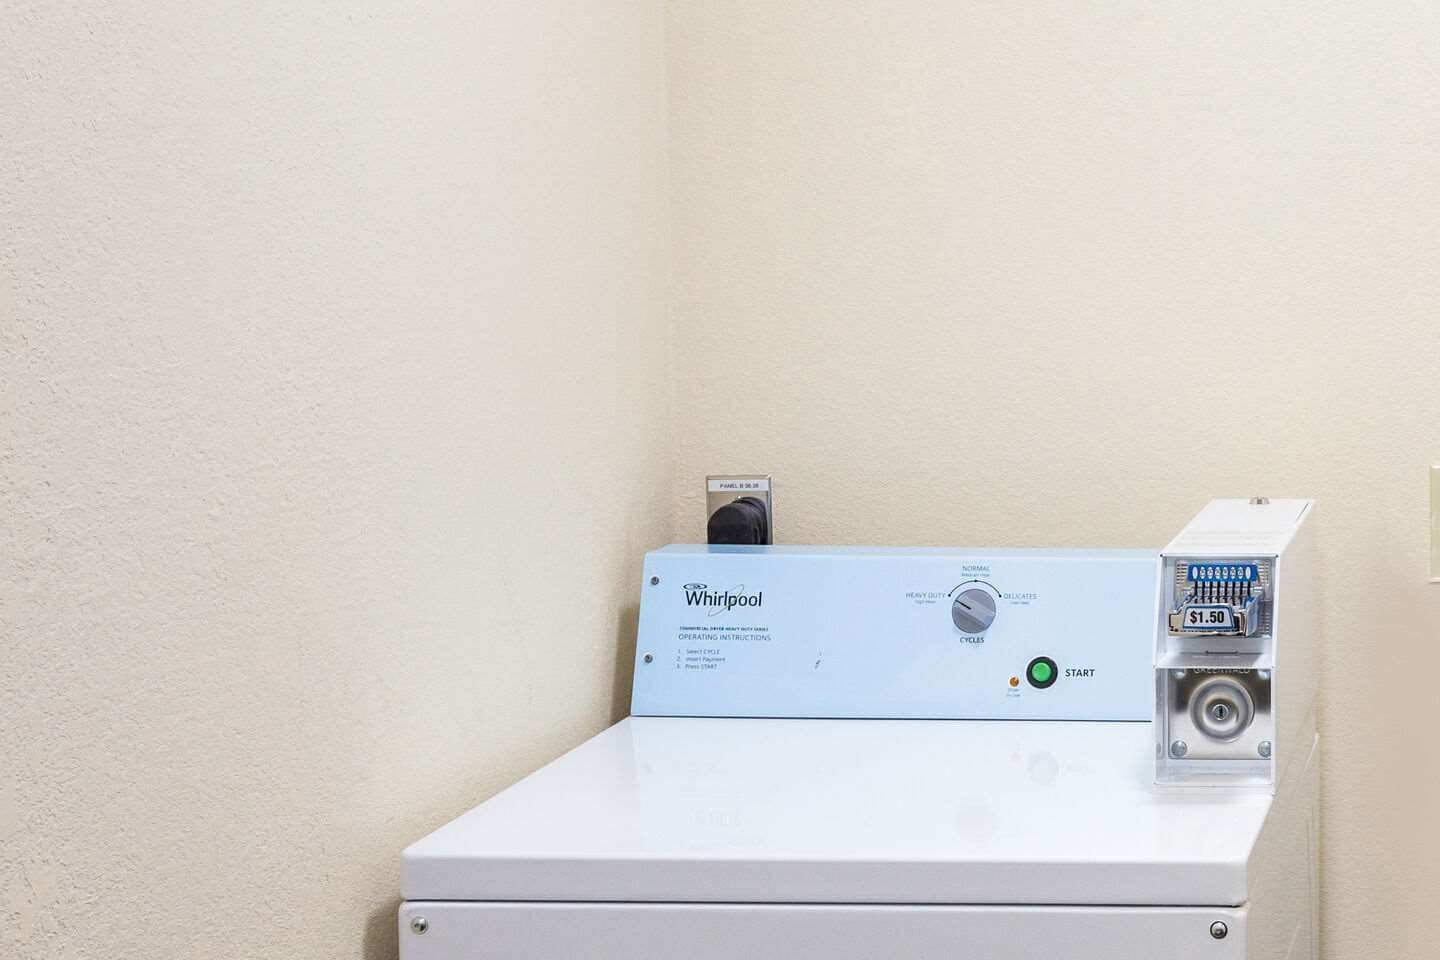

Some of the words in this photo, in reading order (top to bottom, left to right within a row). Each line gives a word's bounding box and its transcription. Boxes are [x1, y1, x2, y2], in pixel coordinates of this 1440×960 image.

[685, 589, 762, 611] Whirlpool
[1189, 610, 1225, 624] $1.50
[678, 633, 718, 641] OPERATING
[719, 633, 772, 642] INSTRUCTIONS
[1064, 668, 1096, 678] START
